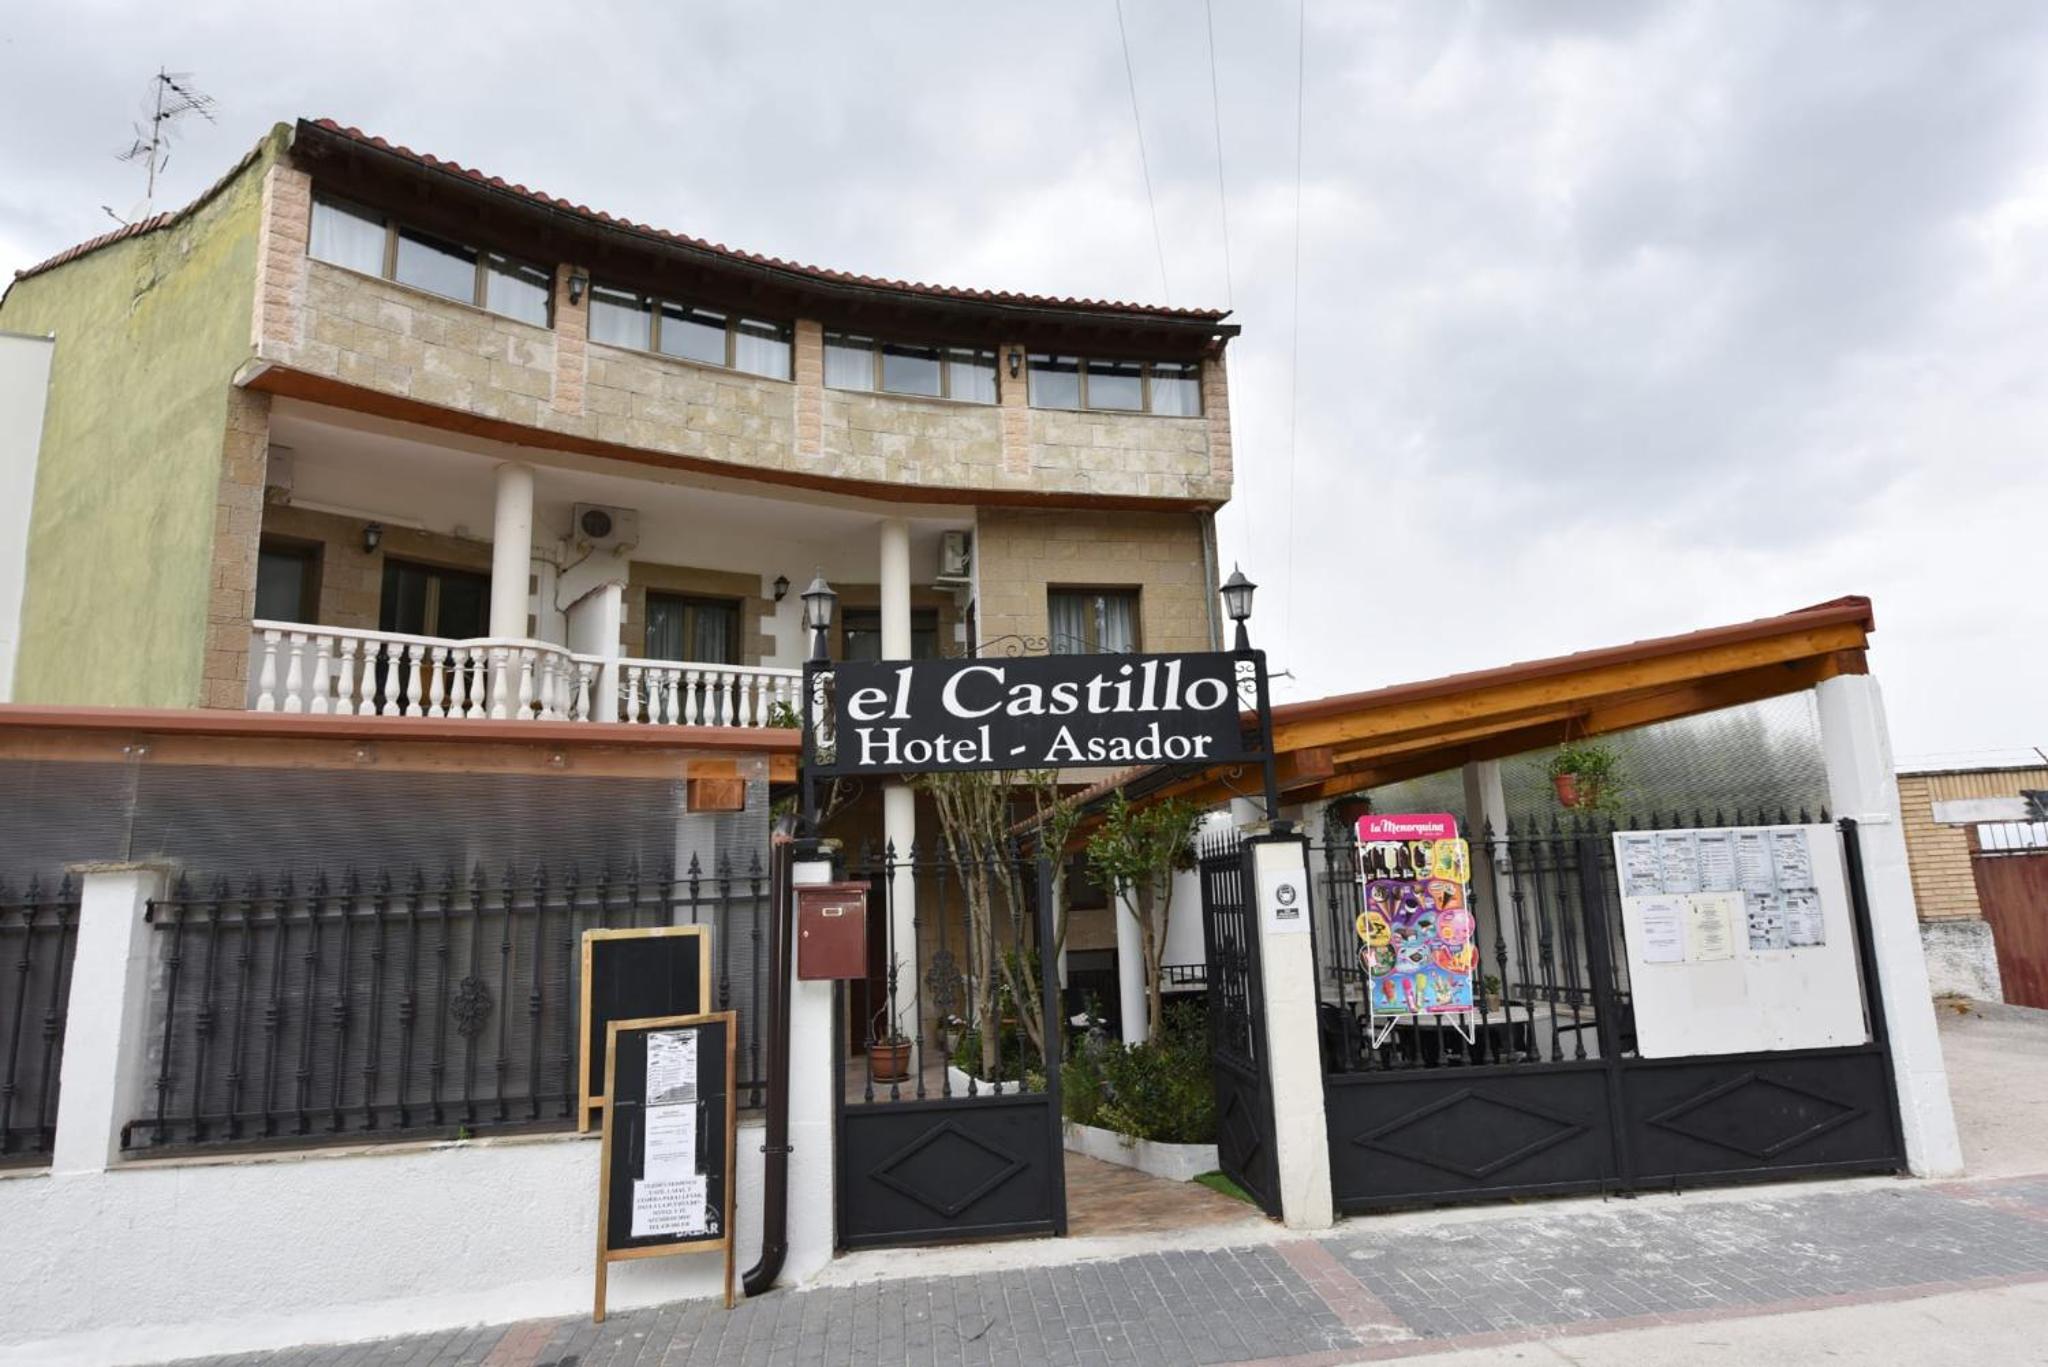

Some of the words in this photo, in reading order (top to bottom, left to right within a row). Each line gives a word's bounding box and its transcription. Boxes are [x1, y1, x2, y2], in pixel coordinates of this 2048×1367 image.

[848, 666, 913, 720] el
[942, 658, 1229, 718] Castillo
[854, 725, 994, 765] Hotel
[1010, 745, 1026, 755] -
[1043, 722, 1213, 761] Asador
[1380, 819, 1444, 835] Menorquina
